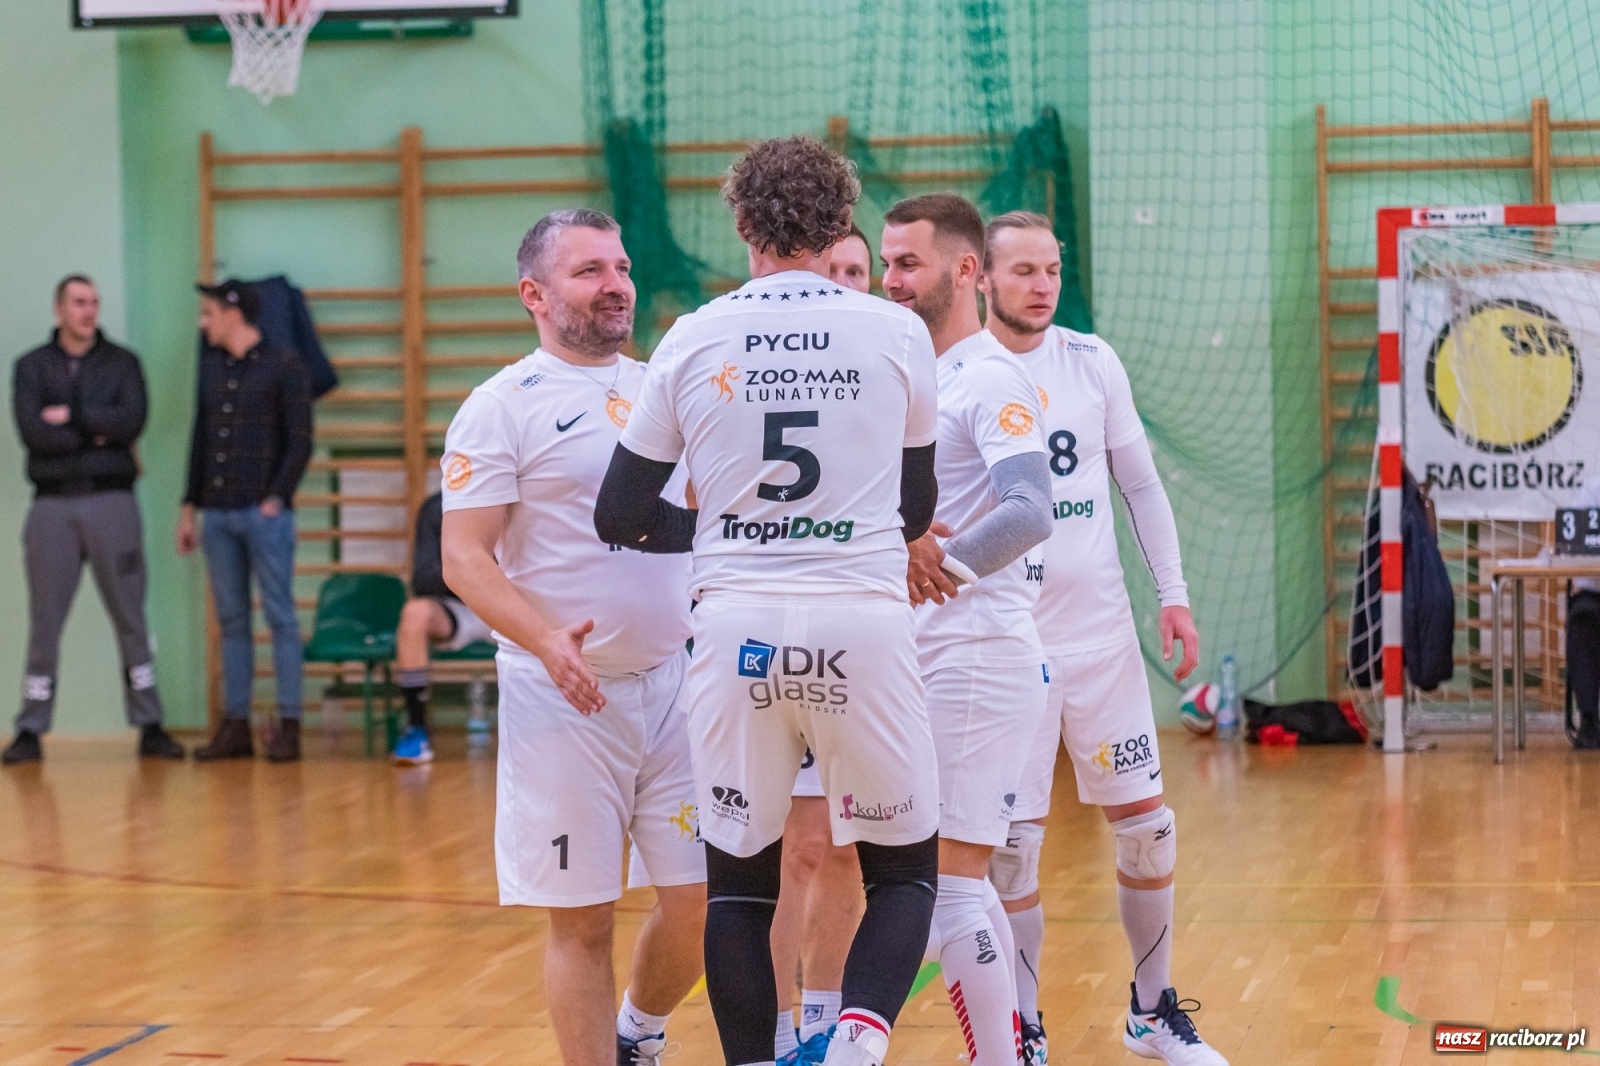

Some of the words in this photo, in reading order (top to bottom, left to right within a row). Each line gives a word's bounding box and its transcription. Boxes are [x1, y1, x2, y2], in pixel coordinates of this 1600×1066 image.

[745, 332, 830, 352] PYCIU
[745, 368, 861, 386] ZOO-MAR
[746, 387, 861, 402] LUNATYCY
[756, 410, 821, 503] 5
[1048, 429, 1078, 477] 8
[1426, 456, 1585, 490] RACIBÓRZ
[719, 513, 854, 545] TropiDog
[1562, 511, 1576, 541] 3
[782, 646, 848, 680] DK
[749, 672, 849, 710] glass
[1111, 734, 1149, 757] ZOO
[1114, 747, 1153, 771] MAR
[551, 834, 569, 871] 1
